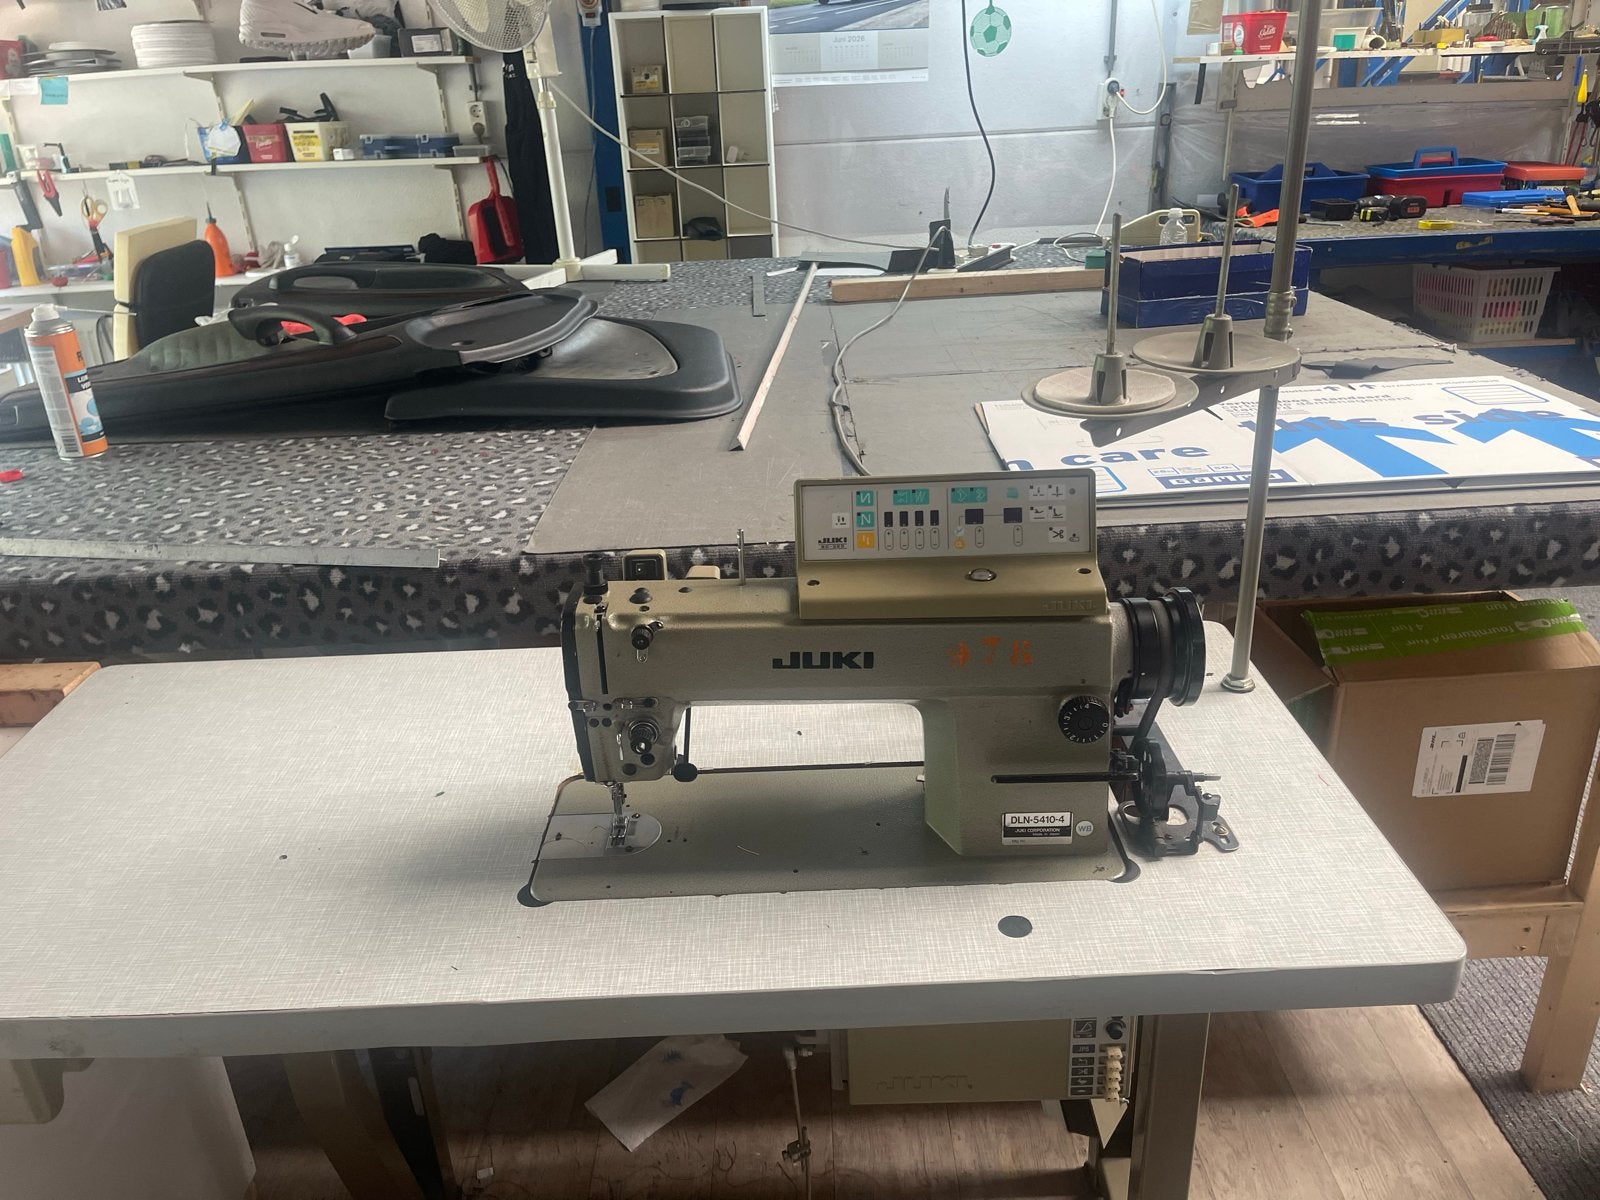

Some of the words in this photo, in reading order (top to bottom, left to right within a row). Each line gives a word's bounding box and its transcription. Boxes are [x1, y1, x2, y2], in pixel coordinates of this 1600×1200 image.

[1413, 409, 1567, 426] side
[1061, 444, 1210, 467] care
[1440, 623, 1514, 643] fournituren
[772, 651, 875, 670] JUKI
[1010, 814, 1065, 826] DLN-5410-4
